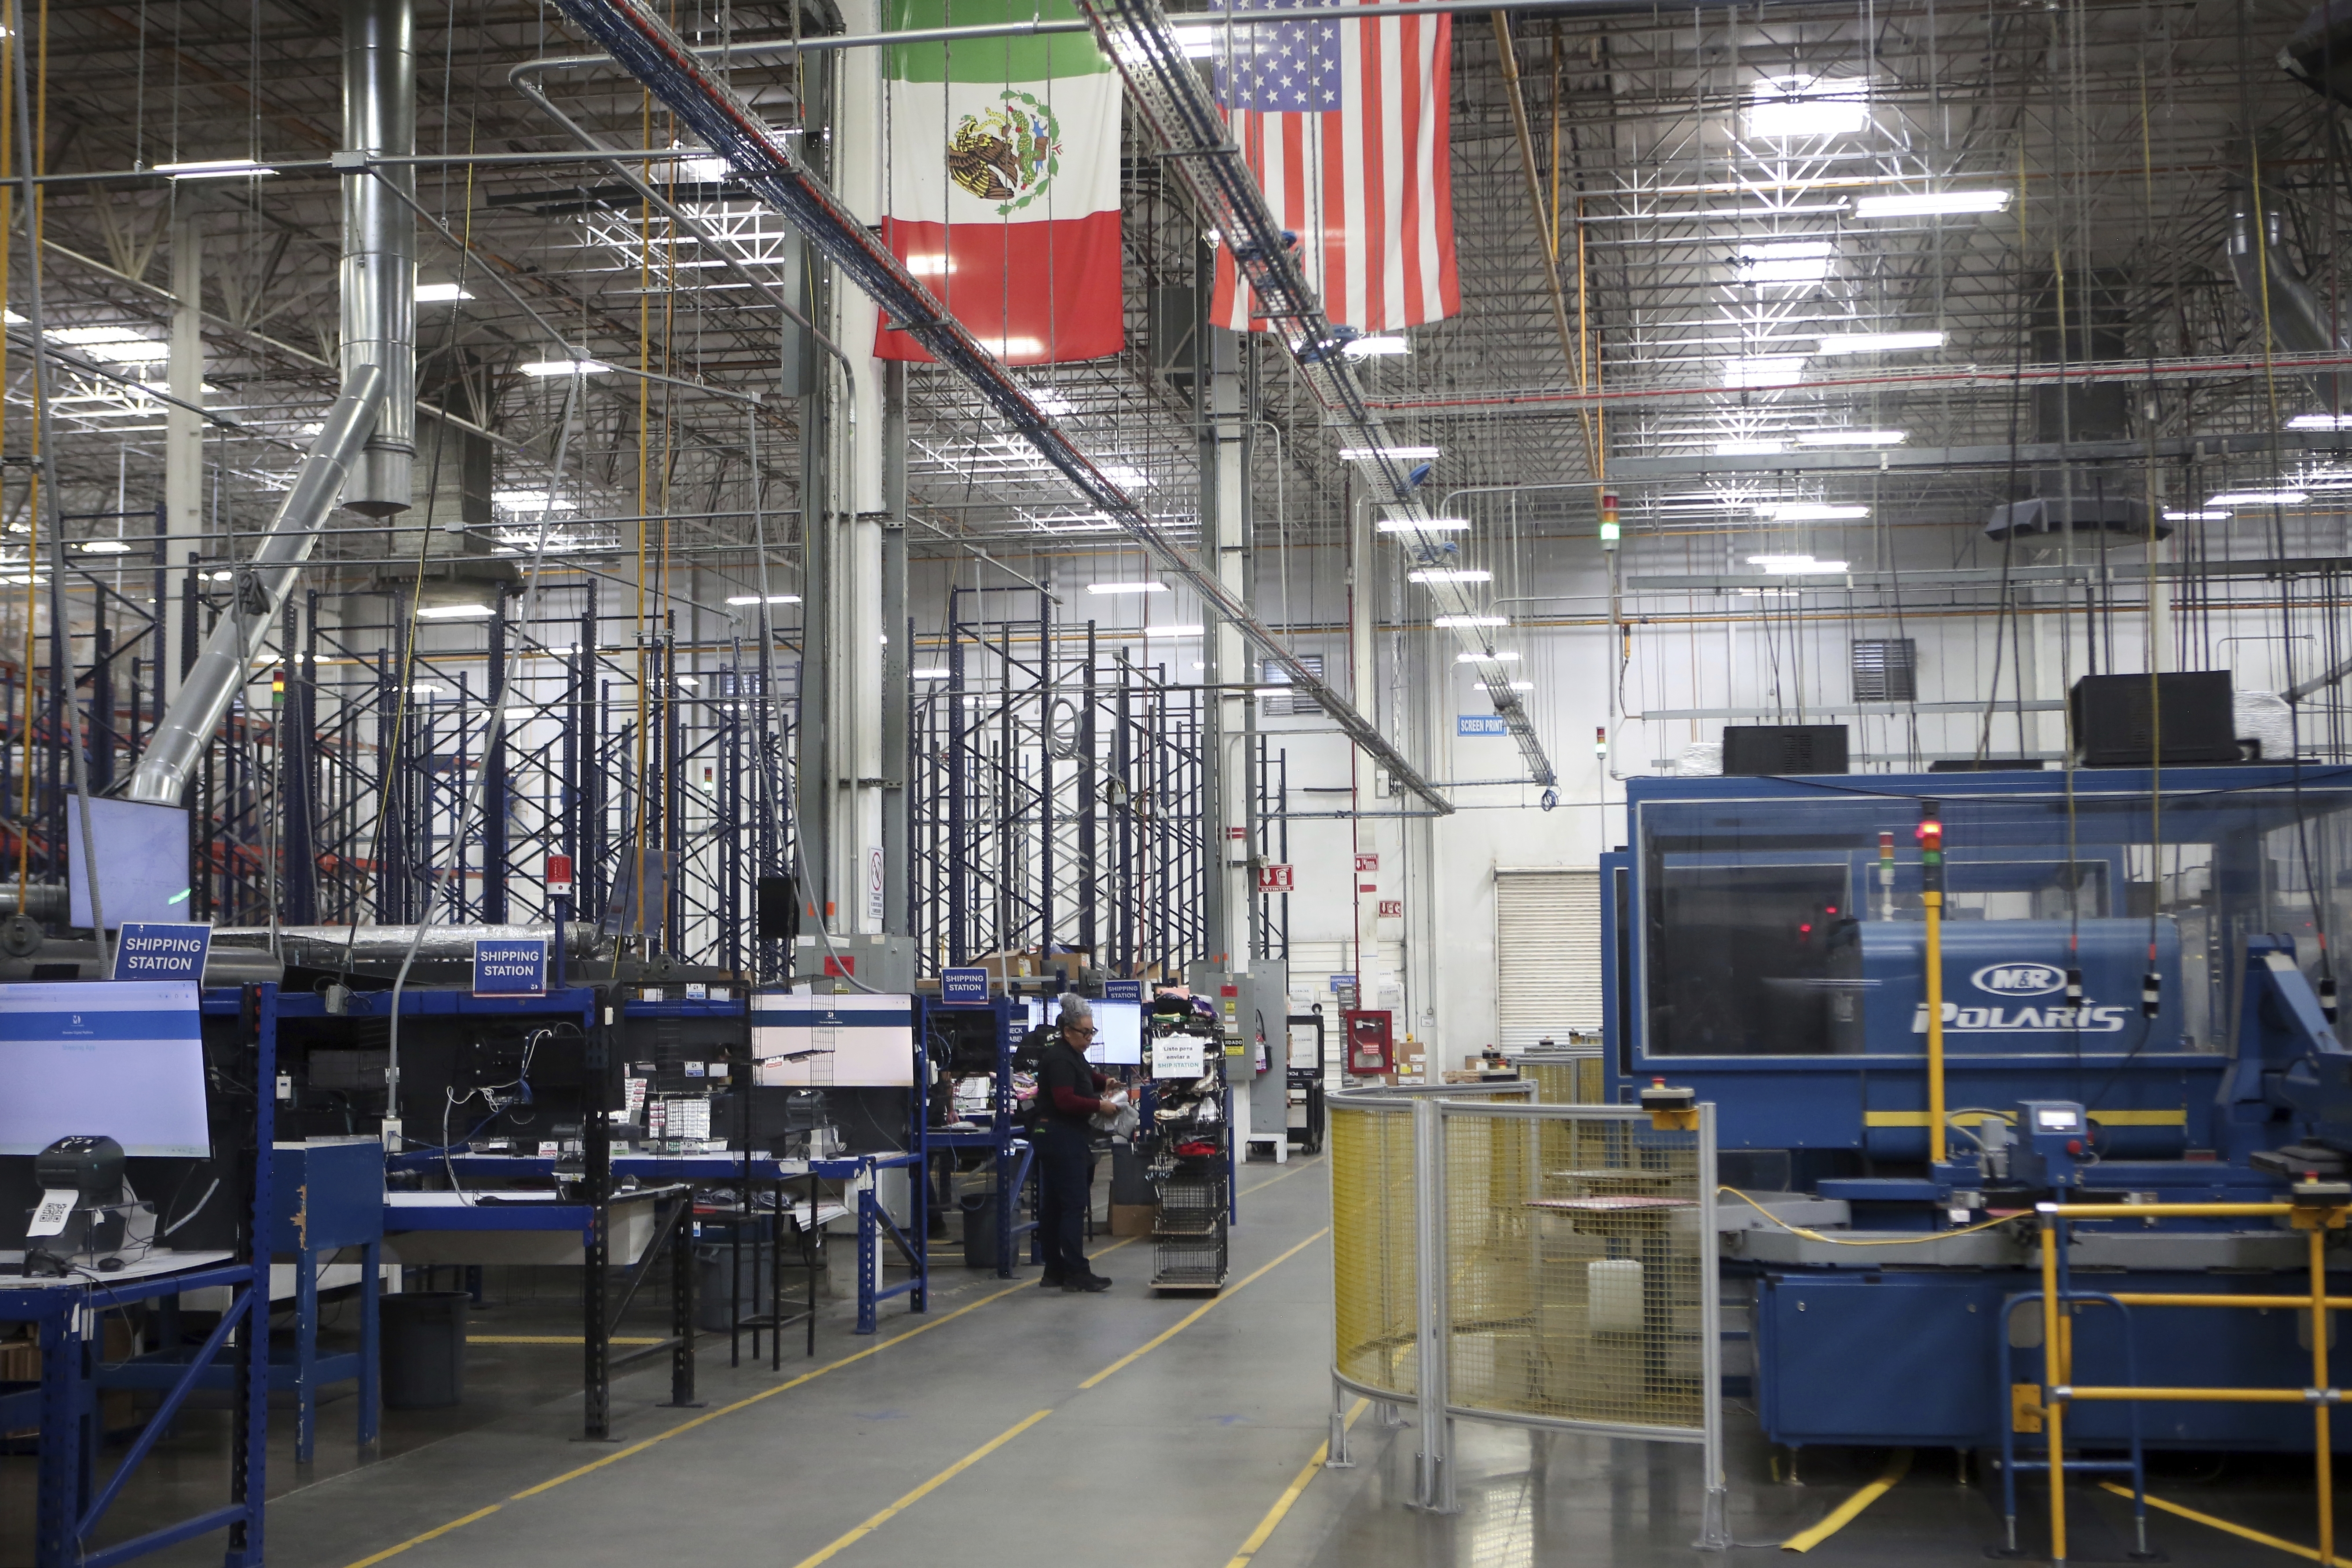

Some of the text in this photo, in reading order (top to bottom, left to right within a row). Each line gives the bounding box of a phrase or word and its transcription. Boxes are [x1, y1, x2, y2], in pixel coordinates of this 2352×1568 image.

[1461, 720, 1503, 732] SCREEN PRINT
[126, 938, 201, 952] SHIPPING
[128, 956, 192, 970] STATION
[481, 951, 539, 961] SHIPPING
[484, 965, 534, 976] STATION
[1992, 969, 2052, 989] M&R
[1912, 999, 2125, 1033] POLARIS
